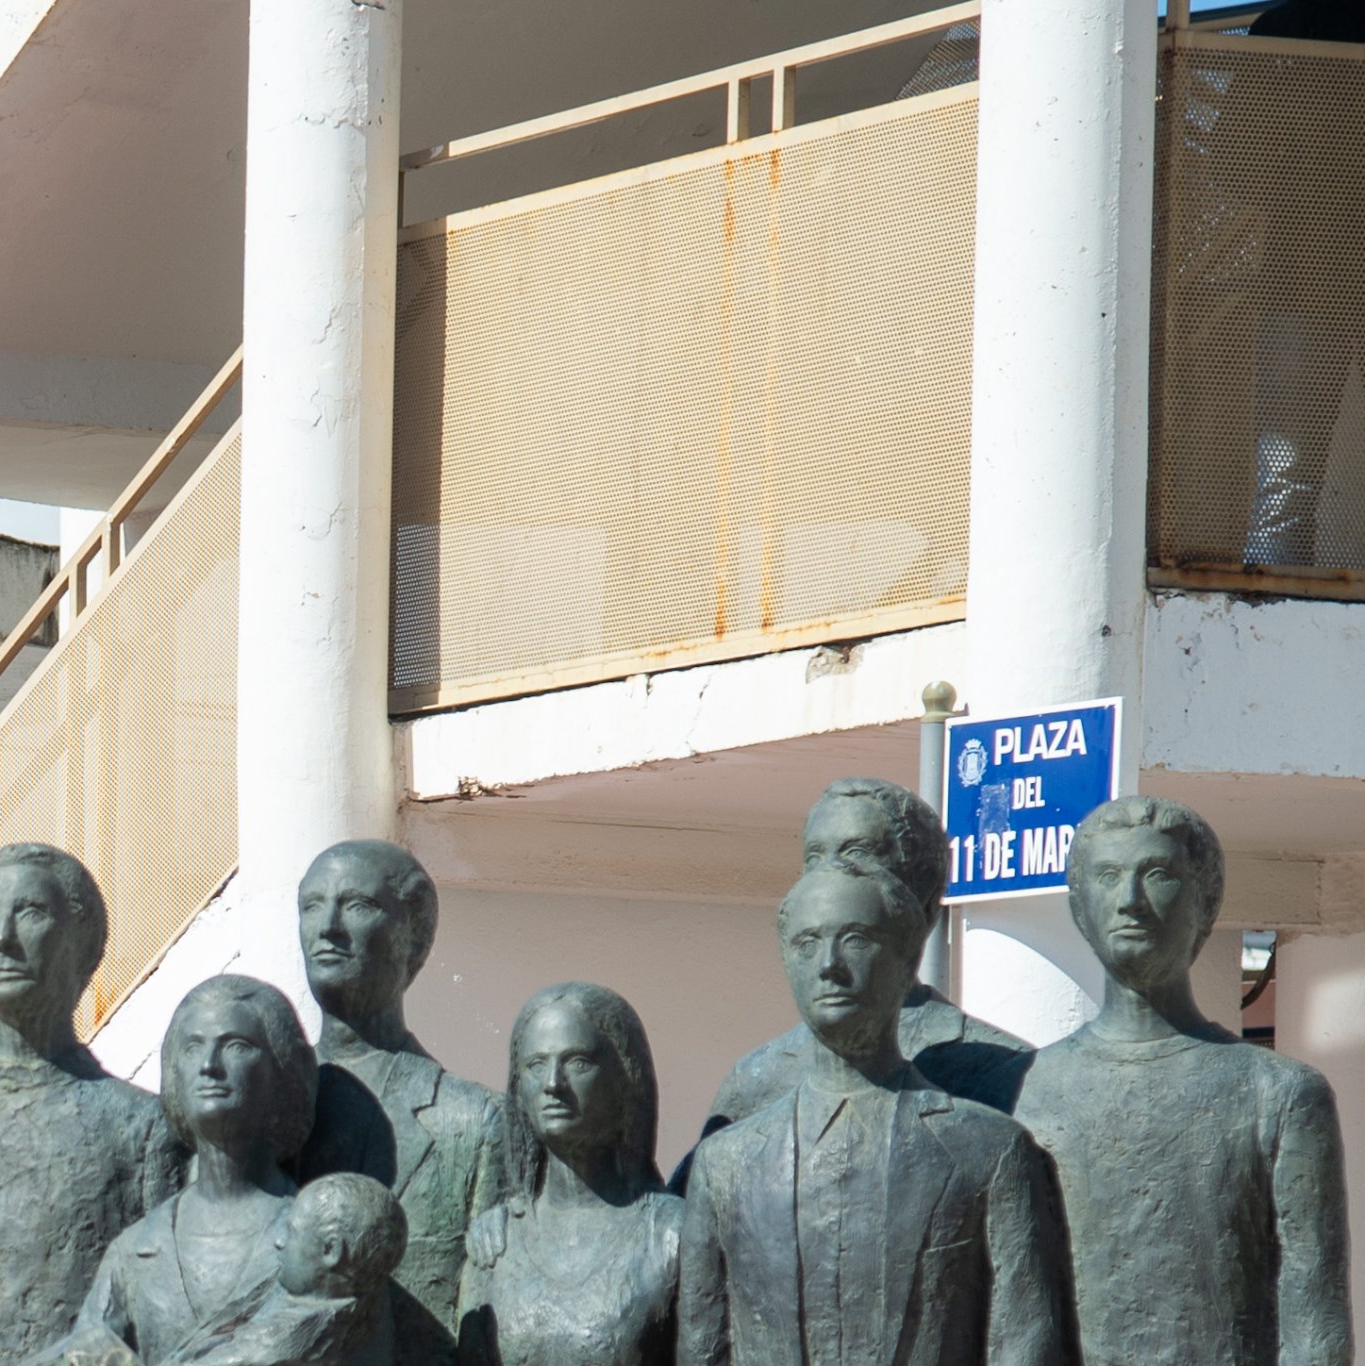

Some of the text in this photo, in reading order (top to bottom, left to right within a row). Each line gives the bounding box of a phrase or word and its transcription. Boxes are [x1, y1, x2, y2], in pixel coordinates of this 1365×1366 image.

[994, 719, 1087, 766] PLAZA
[1012, 776, 1045, 810] DEL
[949, 823, 1080, 883] 11 DE MAR
